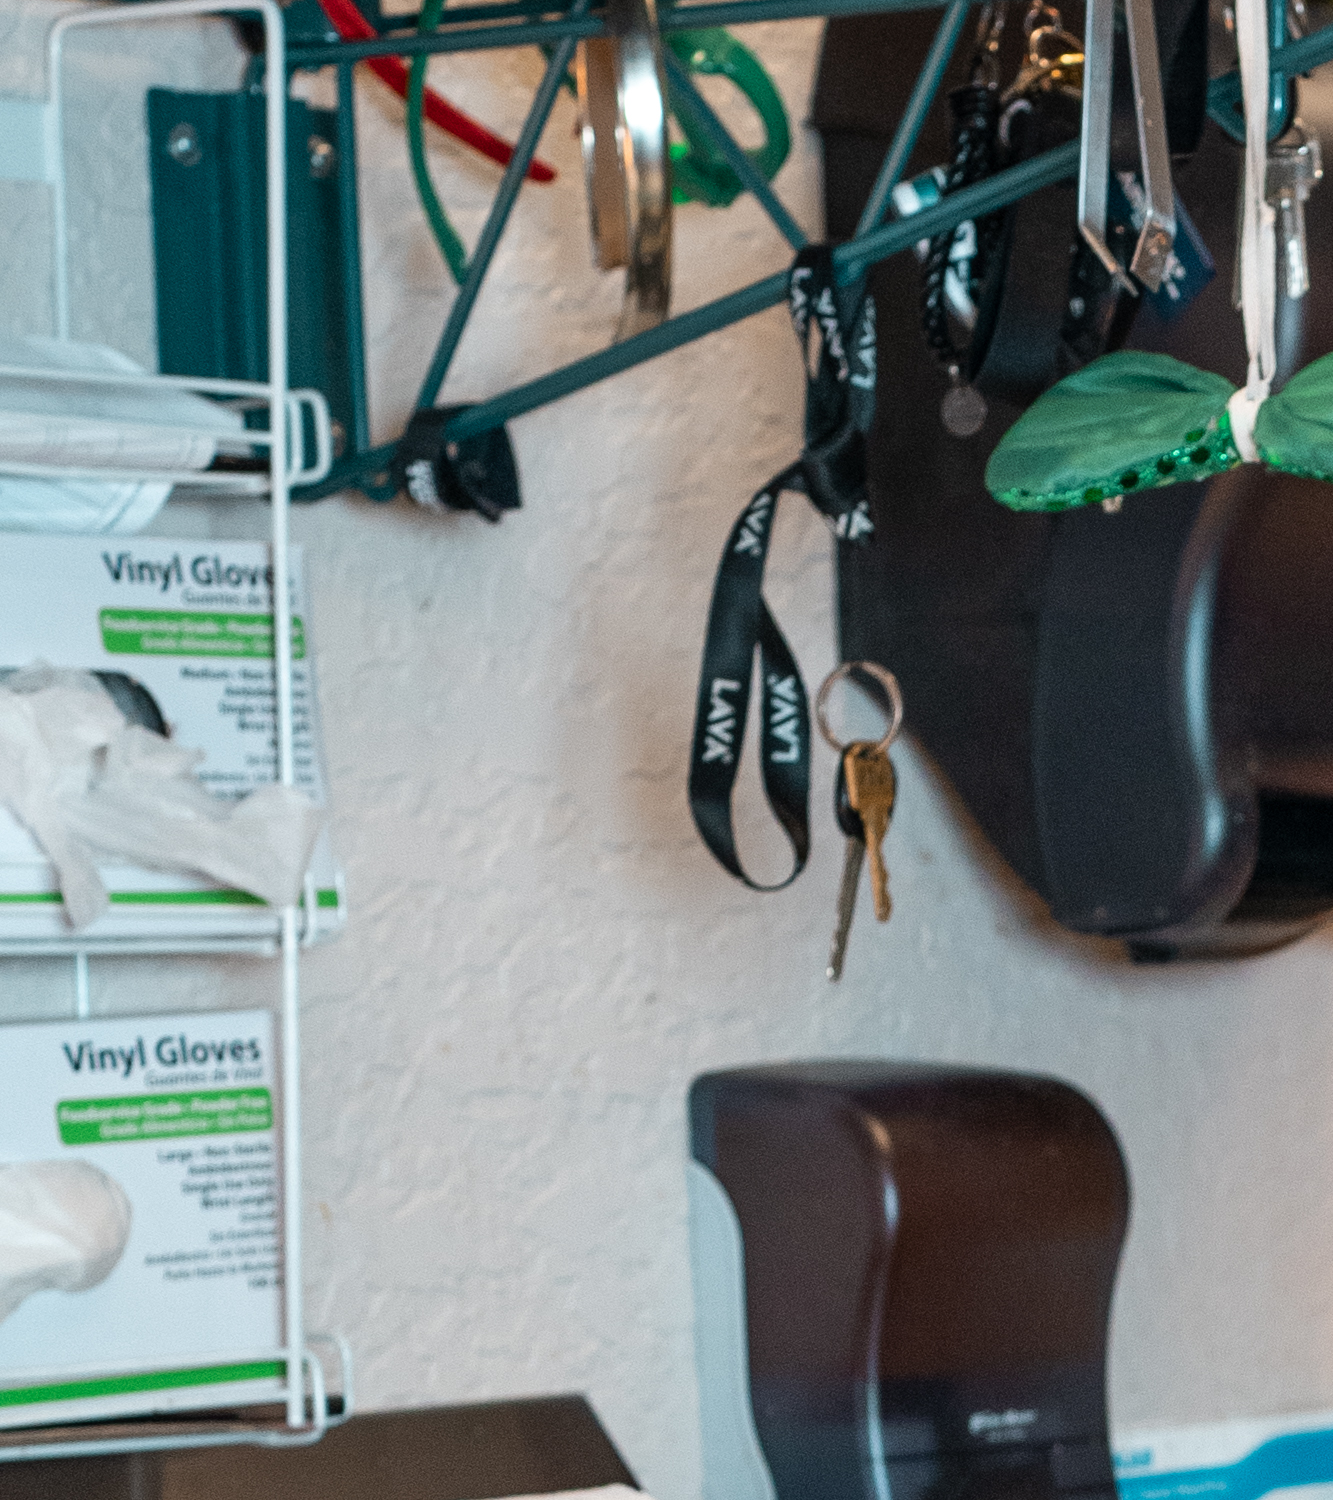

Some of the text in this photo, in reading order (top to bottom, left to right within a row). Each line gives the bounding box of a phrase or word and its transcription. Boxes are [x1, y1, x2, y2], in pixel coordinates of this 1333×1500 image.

[102, 551, 295, 592] Vinyl Glove
[702, 677, 741, 764] LAVA
[766, 673, 800, 764] LAVA
[63, 1031, 261, 1078] Vinyl Gloves
